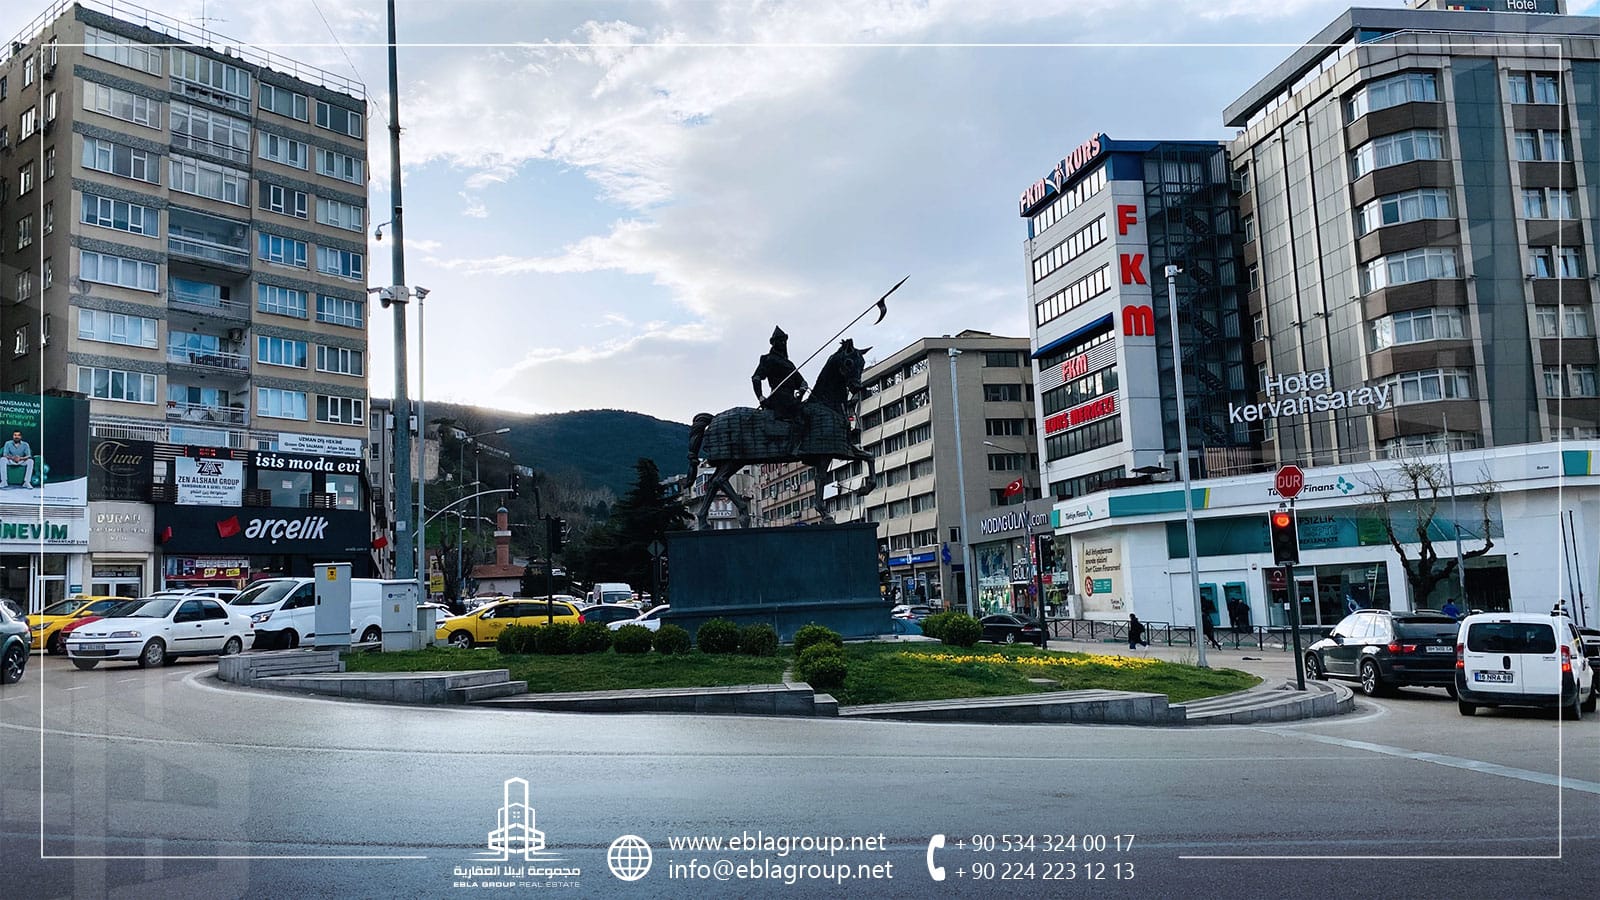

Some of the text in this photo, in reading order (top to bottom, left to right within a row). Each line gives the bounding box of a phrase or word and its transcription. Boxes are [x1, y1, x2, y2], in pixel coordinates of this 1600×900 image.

[1507, 0, 1537, 9] Hotel
[1020, 133, 1101, 214] FKM KURS
[1062, 354, 1089, 382] FKM
[1265, 367, 1331, 397] Hotel
[1228, 384, 1390, 424] kervansaray
[1045, 413, 1069, 434] KURS
[92, 441, 143, 468] Tuna
[255, 453, 361, 473] isis moda evi
[178, 475, 240, 486] ZEN ALSHAM GROUP
[1277, 475, 1301, 488] DUR
[1303, 484, 1335, 493] Finans
[245, 516, 329, 544] arçelik
